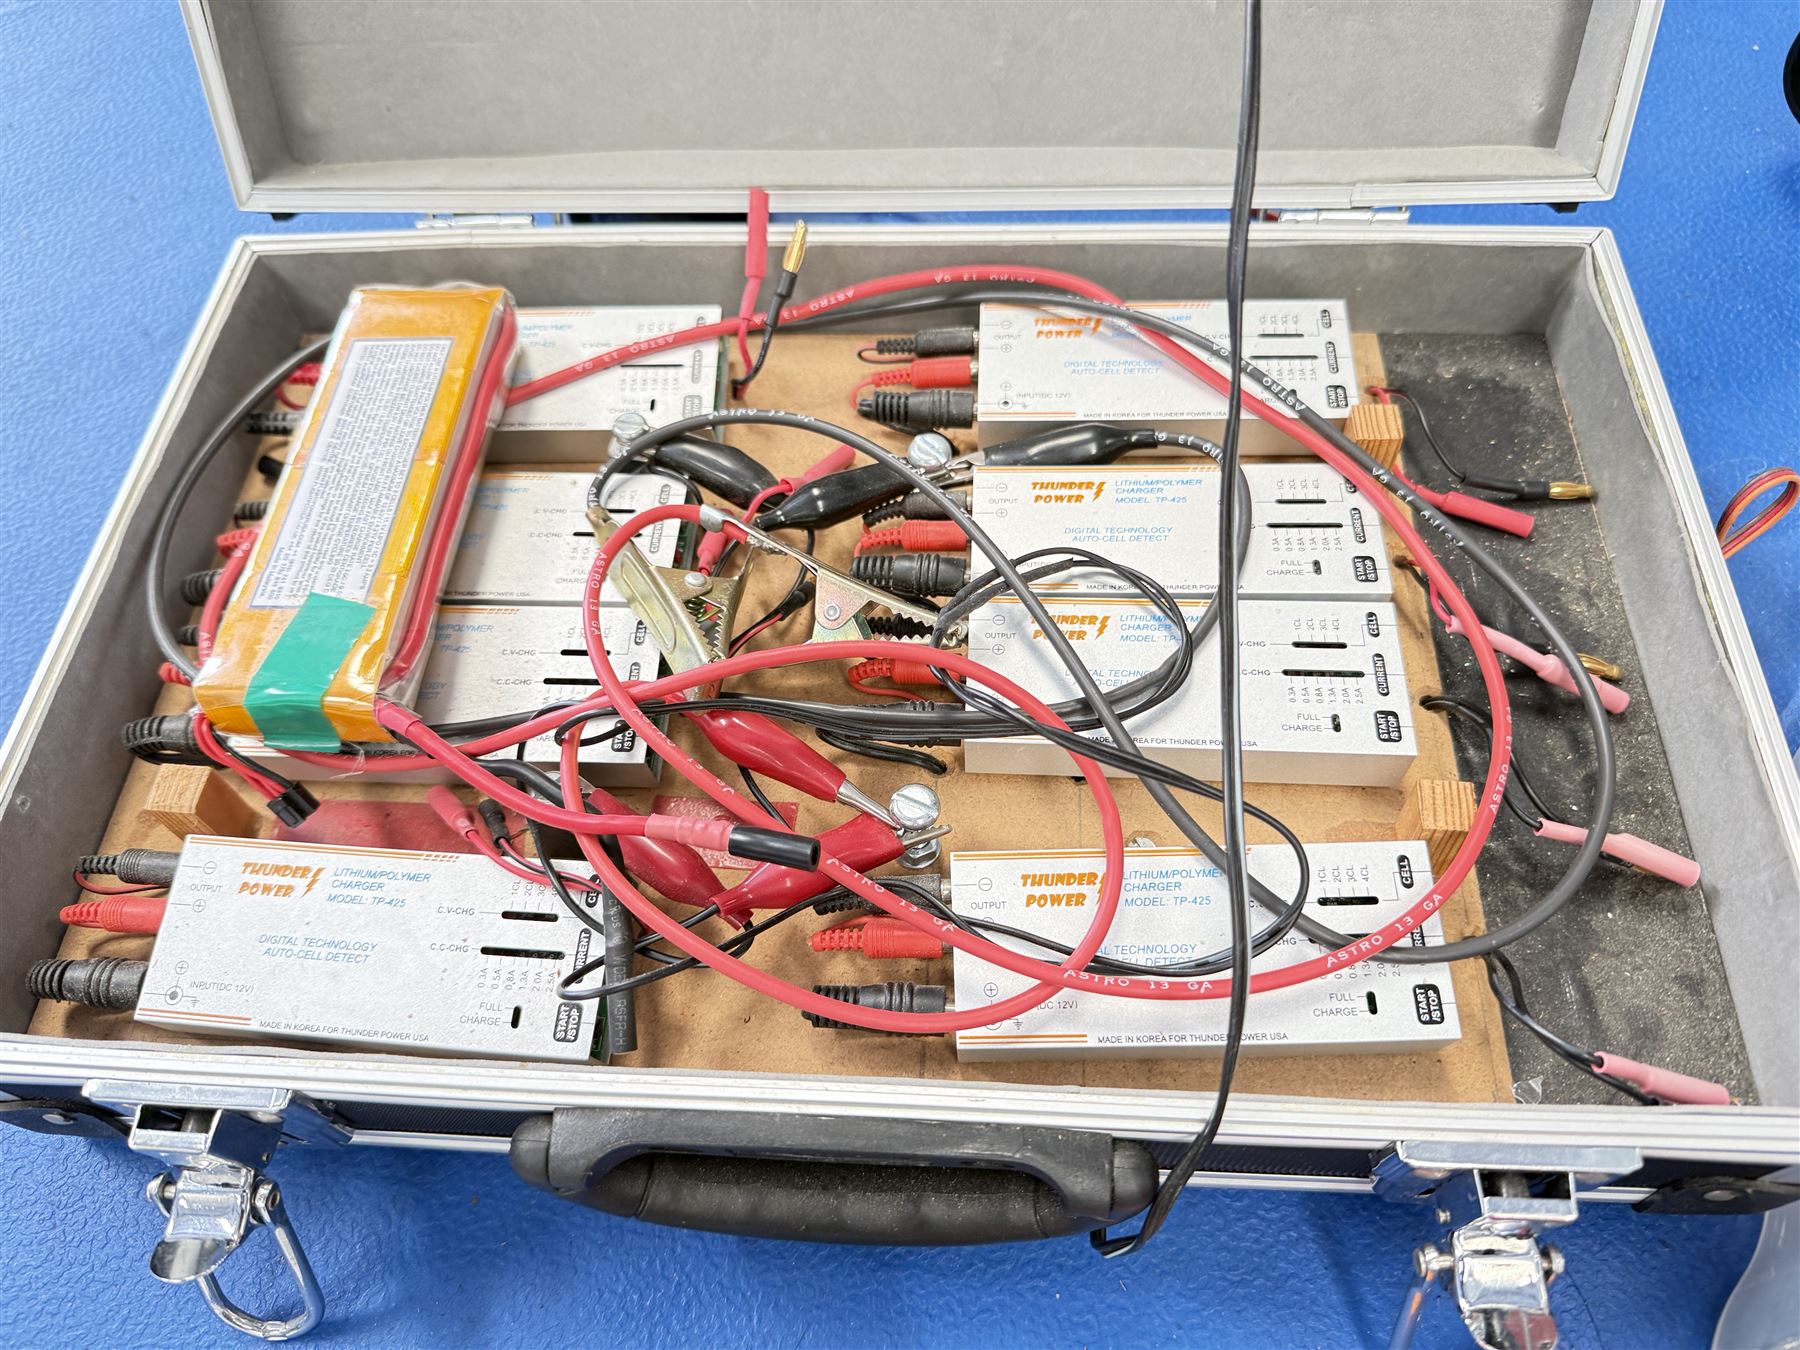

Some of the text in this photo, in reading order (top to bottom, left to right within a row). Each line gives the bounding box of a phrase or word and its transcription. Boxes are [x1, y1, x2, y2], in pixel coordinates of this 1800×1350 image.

[808, 287, 856, 312] ASTRO
[1034, 317, 1092, 327] THUNDER
[1321, 310, 1332, 327] CELL
[1036, 329, 1083, 339] POWER
[629, 335, 676, 354] ASTRO
[1064, 360, 1097, 368] DIGITAL
[1326, 344, 1338, 373] CURRENT
[1071, 367, 1121, 375] AUTO-CELL
[1212, 342, 1306, 412] ASTRO GA
[1328, 387, 1338, 408] START
[1177, 435, 1194, 446] 13
[1115, 479, 1202, 487] LITHIUM/POLYMER
[1372, 467, 1388, 484] GA
[1031, 481, 1095, 490] THUNDER
[660, 486, 670, 504] CELL
[1033, 494, 1085, 503] POWER
[1115, 496, 1187, 504] MODEL: TP-425
[1351, 509, 1365, 542] CURRENT
[1071, 535, 1126, 543] AUTO-CELL
[590, 552, 608, 589] ASTRO
[1354, 558, 1365, 581] START
[1366, 559, 1377, 582] /STOP
[590, 599, 598, 612] 13
[1120, 623, 1172, 632] CHARGER
[1293, 618, 1302, 631] 1CL
[1306, 618, 1315, 631] 2CL
[1319, 618, 1328, 631] 3CL
[1332, 617, 1340, 631] 4CL
[1368, 613, 1379, 635] CELL
[496, 678, 532, 686] C.C-CHG
[1373, 655, 1388, 695] CURRENT
[1288, 686, 1297, 704] 0.3A
[1301, 686, 1310, 704] 0.5A
[1315, 686, 1324, 704] 0.8A
[1328, 687, 1337, 705] 1.3A
[1341, 687, 1351, 705] 2.0A
[1355, 687, 1364, 705] 2.5A
[1297, 713, 1320, 721] FULL
[1281, 724, 1323, 732] CHARGE
[1378, 713, 1388, 740] START
[1388, 715, 1400, 741] /STOP
[1169, 738, 1206, 746] THUNDER
[1489, 763, 1509, 815] ASTRO
[241, 862, 312, 879] THUNDER
[333, 867, 432, 882] LITHIUM/POLYMER
[1317, 866, 1327, 882] 1CL
[1331, 865, 1341, 882] 2CL
[1346, 865, 1357, 882] 3CL
[1360, 864, 1370, 882] 4CL
[1399, 858, 1412, 884] CELL
[189, 883, 223, 893] OUTPUT
[331, 879, 385, 891] CHARGER
[1020, 871, 1098, 888] THUNDER
[1124, 881, 1182, 892] CHARGER
[238, 881, 295, 897] POWER
[826, 857, 955, 932] ASTRO 13 GA
[327, 893, 407, 908] MODEL: TP-425
[970, 901, 1007, 910] OUTPUT
[1025, 892, 1087, 908] POWER
[1125, 895, 1211, 907] MODEL: TP-425
[437, 905, 476, 916] C.V-CHG
[1326, 893, 1443, 968] ASTRO 13 GA
[258, 934, 378, 951] DIGITAL TECHNOLOGY
[430, 942, 469, 953] C.C-CHG
[1114, 944, 1197, 955] TECHNOLOGY
[263, 947, 370, 964] AUTO-CELL DETECT
[477, 967, 488, 989] 0.3A
[491, 968, 502, 990] 0.5A
[504, 969, 515, 991] 0.8A
[519, 969, 529, 991] 1.3A
[532, 970, 543, 992] 2.0A
[545, 971, 556, 993] 2.5A
[1063, 968, 1213, 994] ASTRO 13 GA
[189, 980, 255, 995] INPUT(DC 12V)
[1057, 1001, 1078, 1010] 12V)
[1329, 992, 1355, 1002] FULL
[1415, 987, 1430, 1022] START
[1428, 989, 1442, 1022] /STOP
[478, 1002, 502, 1012] FULL
[1313, 1008, 1358, 1018] CHARGE
[459, 1014, 502, 1026] CHARGE
[555, 1004, 570, 1039] START
[566, 1007, 582, 1041] /STOP
[259, 1020, 430, 1042] MADE IN KOREA FOR THUNDER POWER USA
[1097, 1032, 1288, 1044] MADE IN KOREA FOR THUNDE OWER USA
